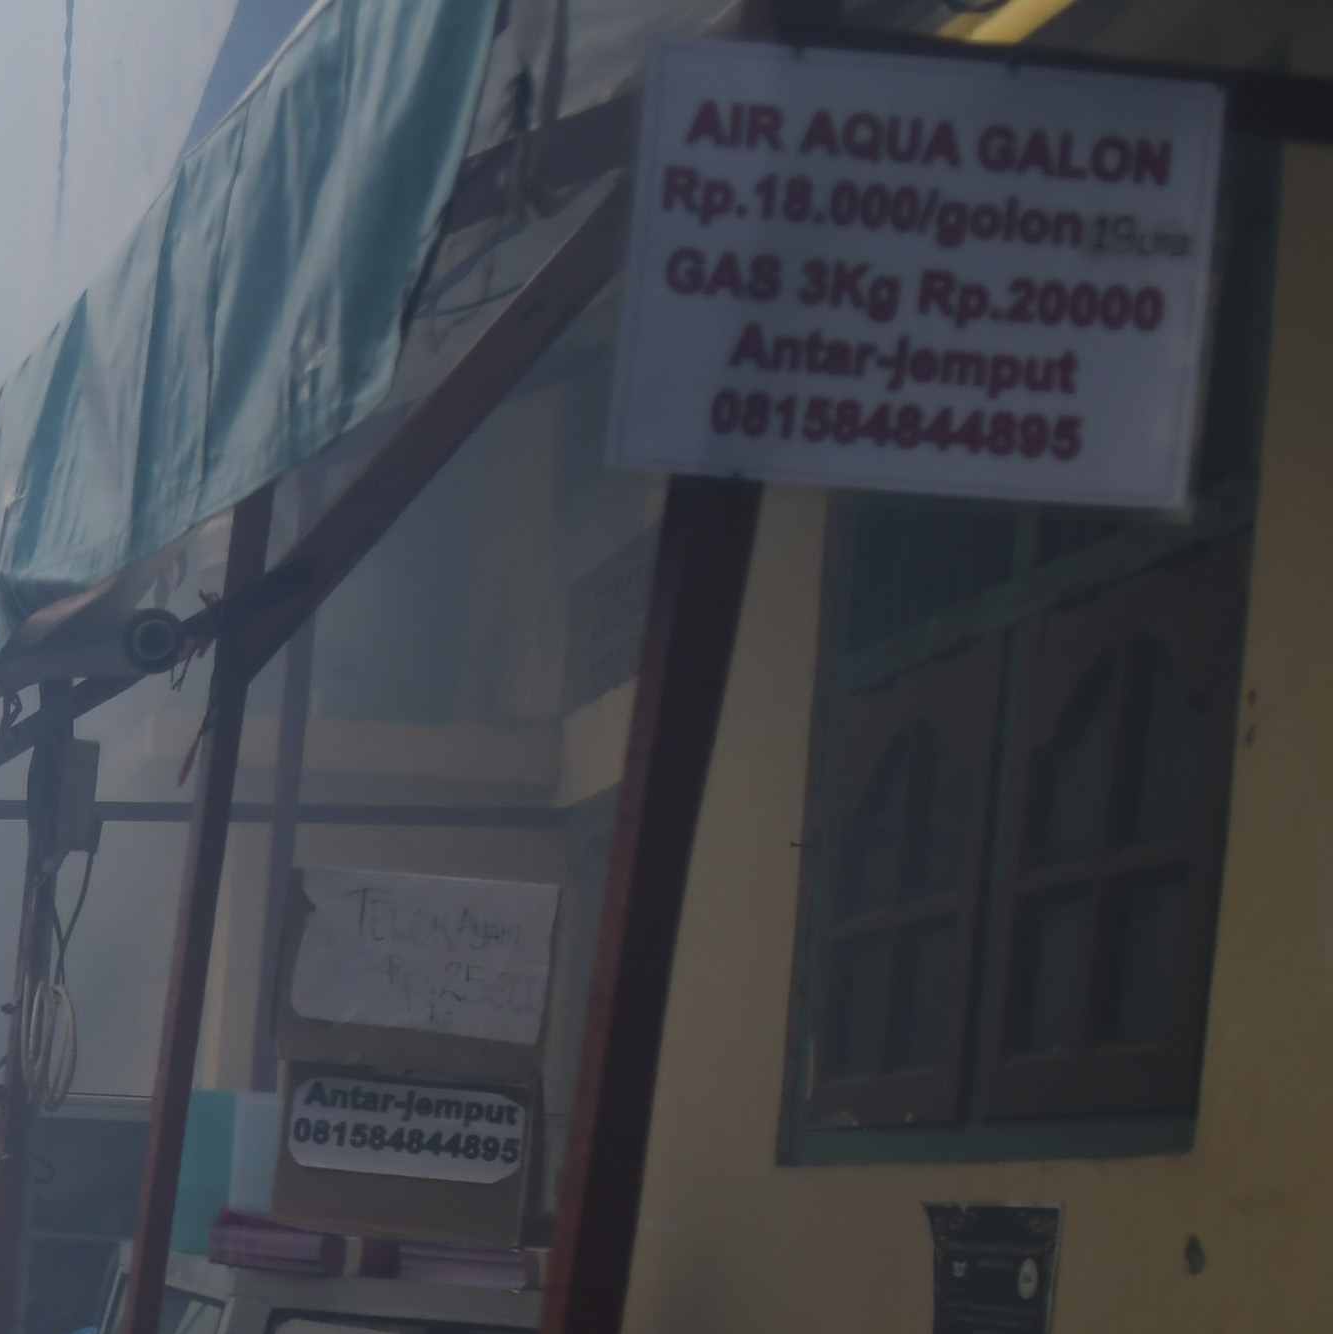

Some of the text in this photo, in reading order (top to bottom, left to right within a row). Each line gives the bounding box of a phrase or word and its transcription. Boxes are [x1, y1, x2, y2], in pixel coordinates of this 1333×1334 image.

[686, 101, 1173, 187] AIR AQUA GALON
[662, 165, 1085, 249] Rp.18.000/golon
[665, 247, 1165, 331] GAS 3Kg Rp.20000
[729, 321, 1077, 398] Antar-jemput
[710, 389, 1083, 461] 081584844895
[293, 1117, 521, 1163] 081584844895
[303, 1081, 519, 1128] Antar-jemput
